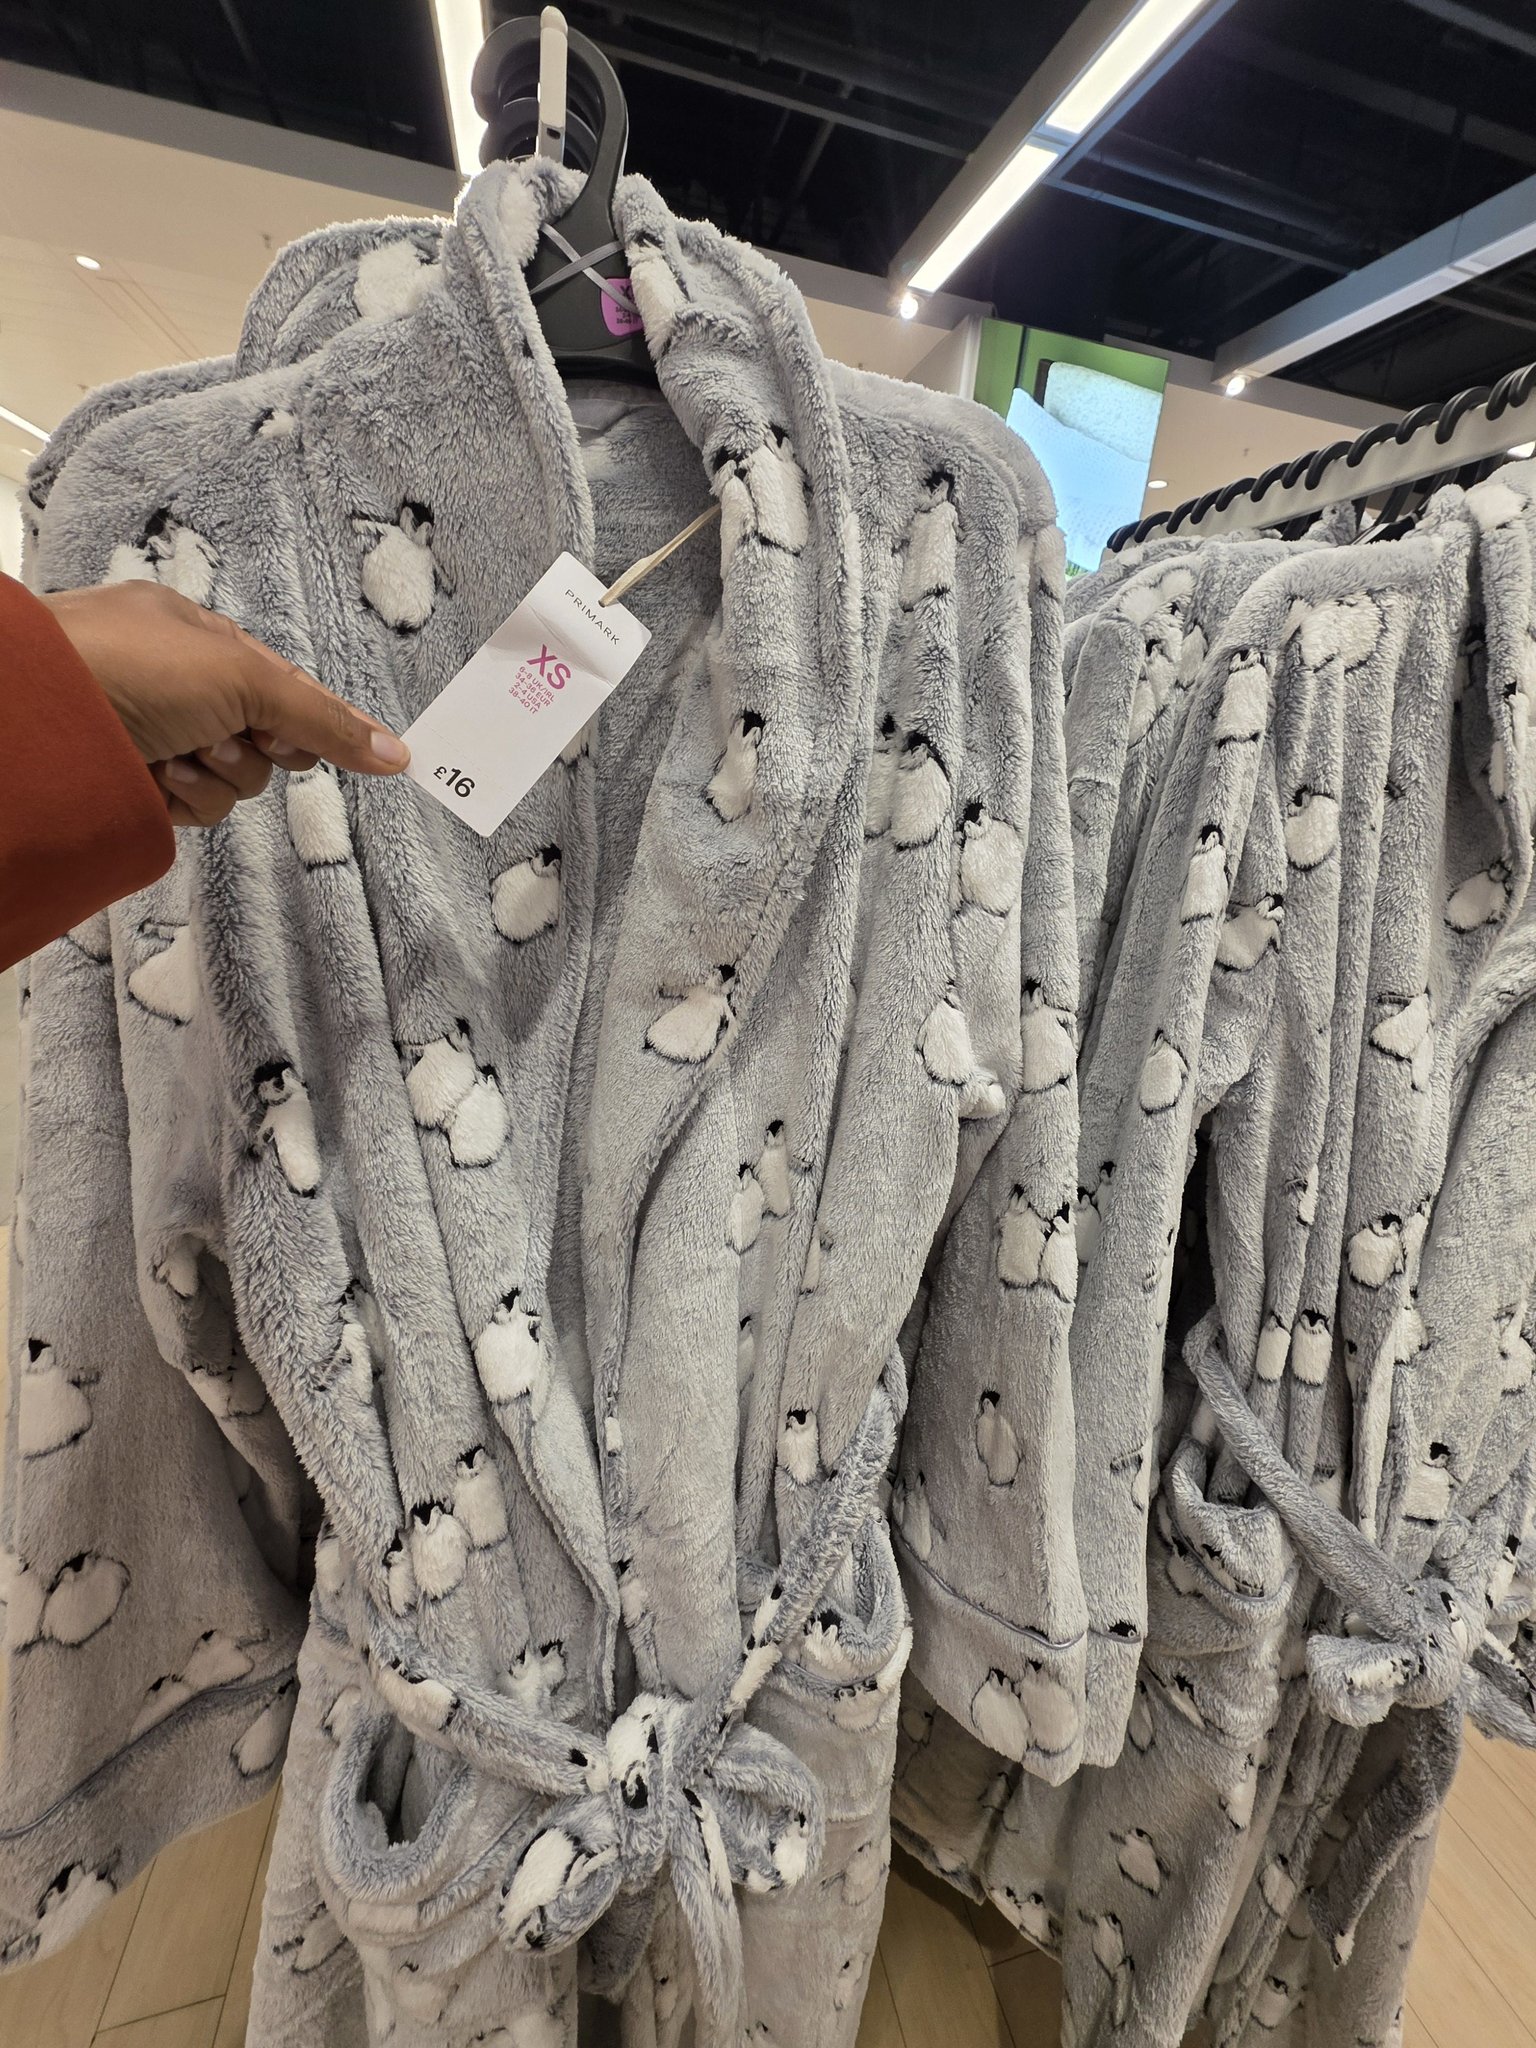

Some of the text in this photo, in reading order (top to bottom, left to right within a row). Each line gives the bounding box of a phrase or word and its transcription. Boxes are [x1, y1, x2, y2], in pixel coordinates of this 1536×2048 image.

[564, 588, 620, 646] PRIMARK
[519, 666, 555, 702] 6-8 UK/IRL
[526, 643, 571, 690] XS
[508, 687, 538, 715] 38-40 IT
[513, 682, 541, 709] 2-4 USA
[515, 672, 551, 707] 34-36 EUR
[433, 766, 475, 798] £16
